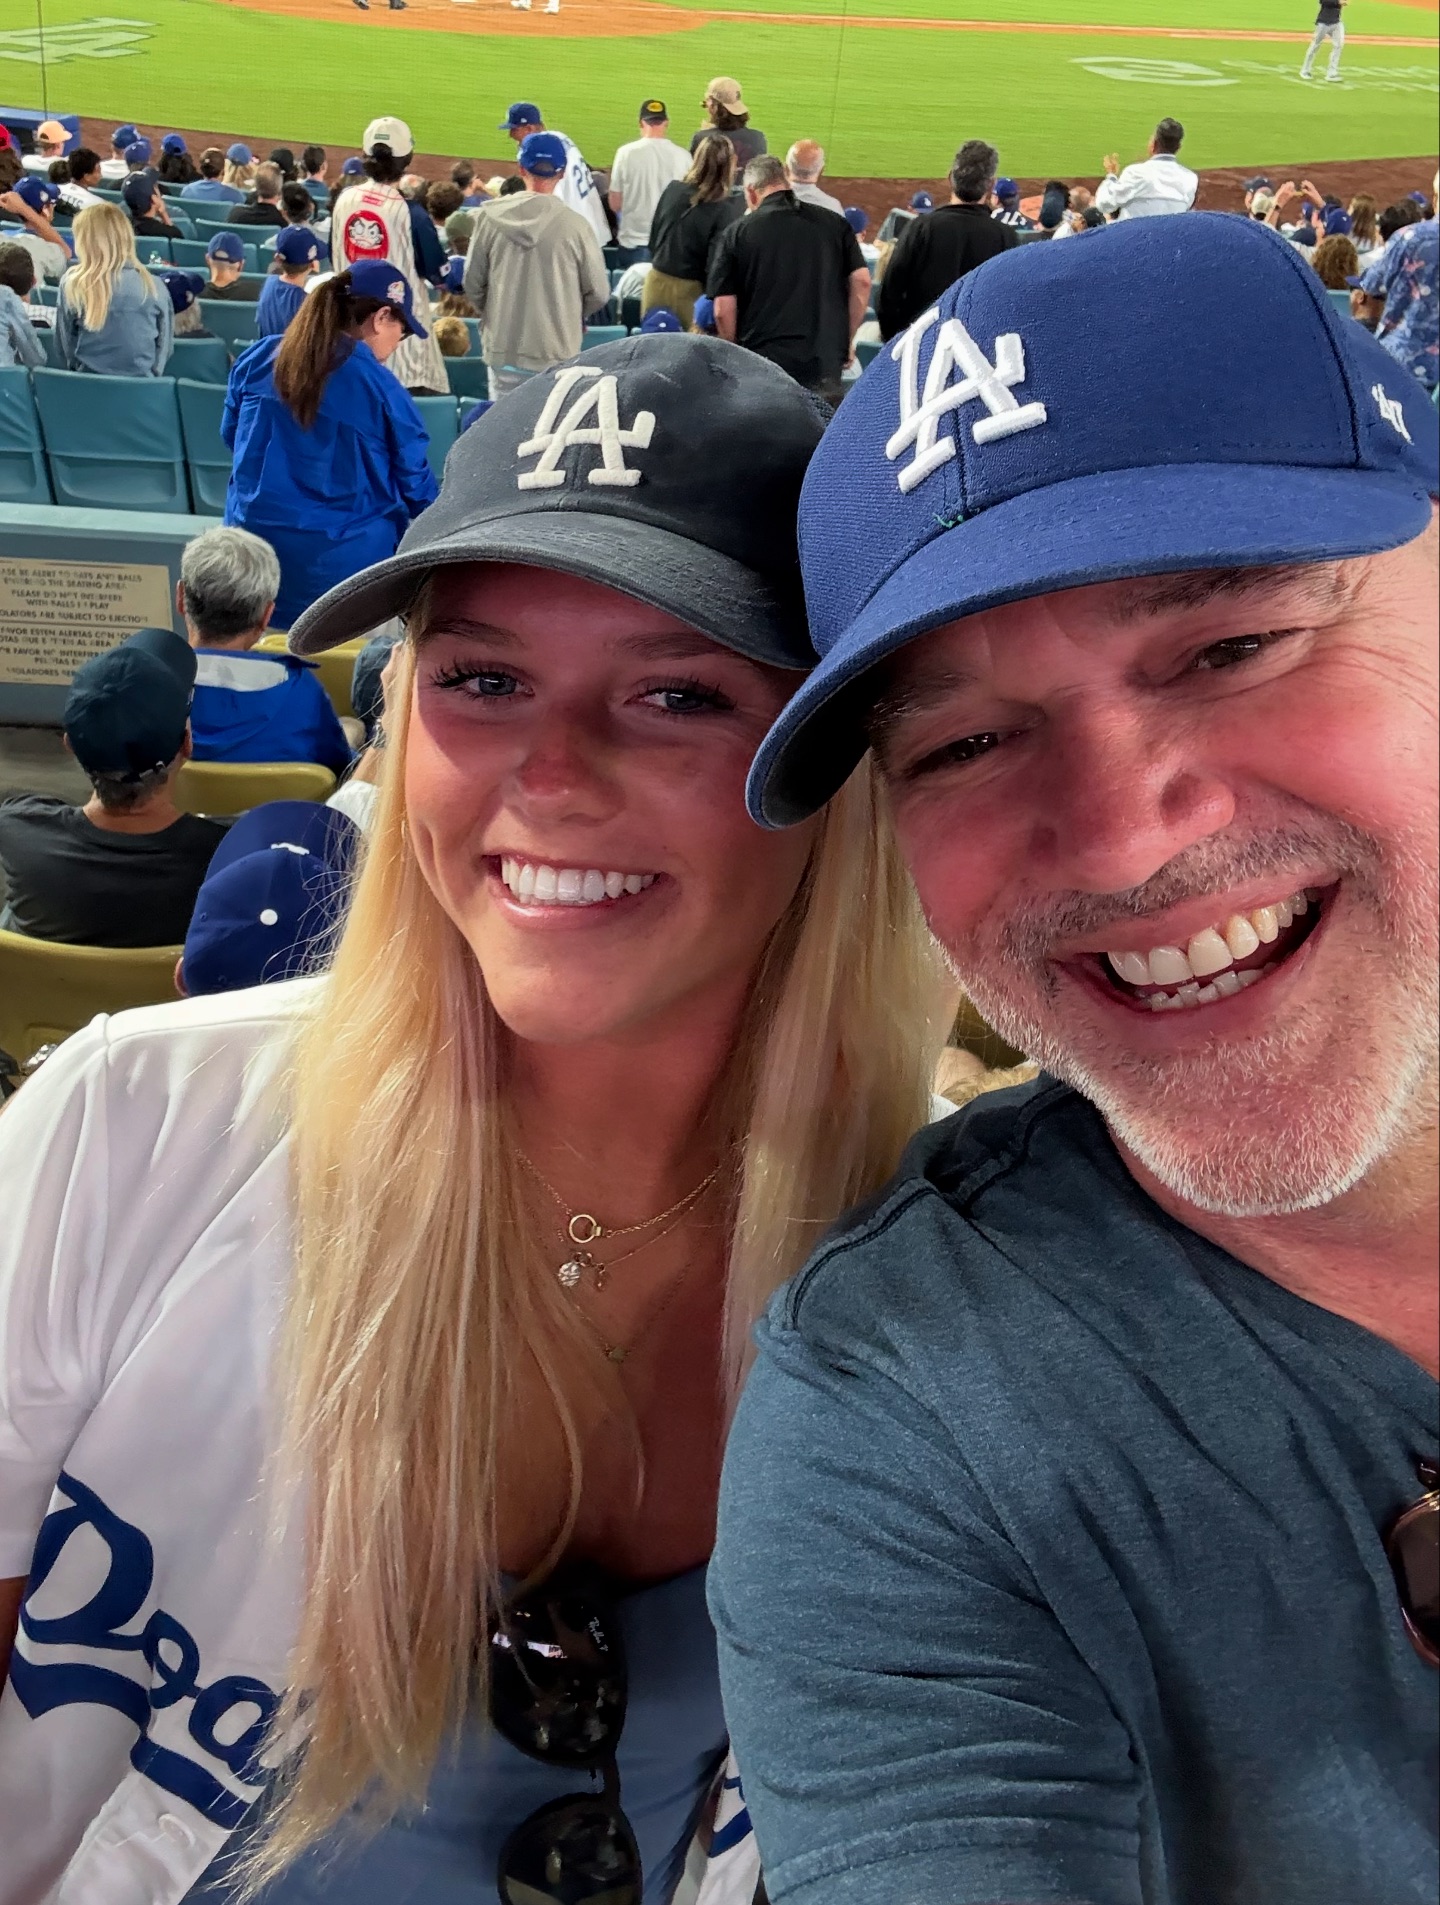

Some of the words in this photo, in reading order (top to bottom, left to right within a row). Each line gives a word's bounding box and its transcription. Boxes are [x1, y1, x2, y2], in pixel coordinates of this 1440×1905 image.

[886, 305, 1048, 494] LA
[516, 365, 657, 491] LA
[67, 579, 102, 589] SEATING
[95, 614, 106, 622] TO
[34, 657, 69, 665] PELTAS
